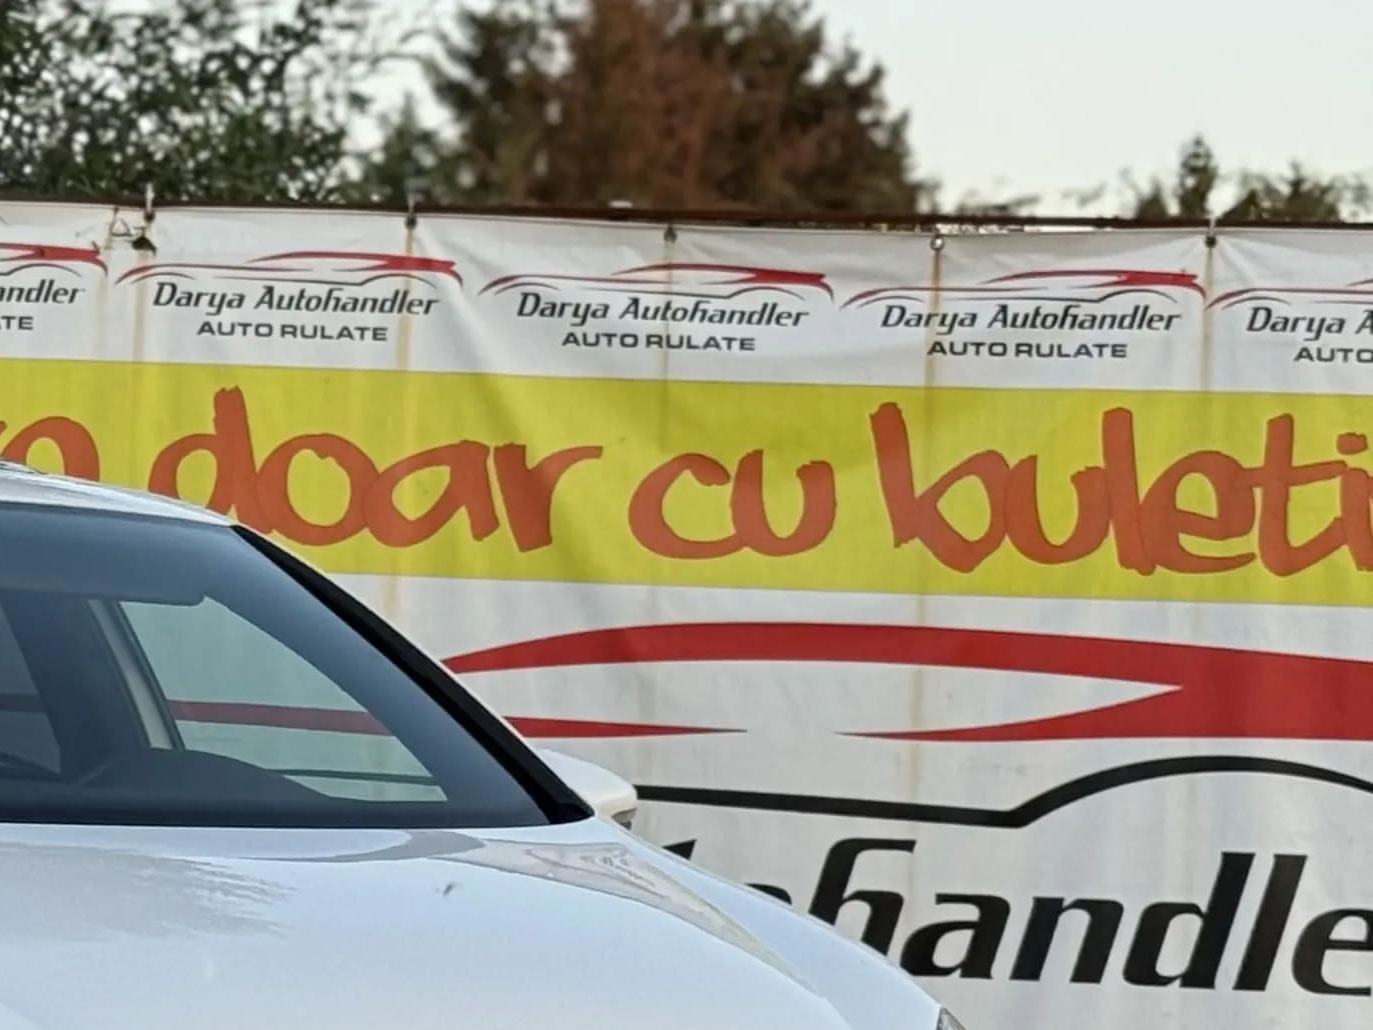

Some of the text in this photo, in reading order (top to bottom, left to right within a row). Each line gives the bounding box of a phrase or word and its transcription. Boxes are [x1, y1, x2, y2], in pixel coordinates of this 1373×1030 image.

[153, 282, 439, 316] Darya Autohandler
[517, 292, 809, 327] Darya Autohandler
[197, 321, 388, 342] AUTO RULATE
[881, 304, 1181, 336] Darya Autohandler
[1246, 306, 1346, 342] Darya
[562, 332, 755, 351] AUTO RULATE
[927, 340, 1128, 359] AUTO RULATE
[1293, 346, 1373, 363] AUTO
[147, 386, 604, 552] doar
[628, 449, 837, 559] cu
